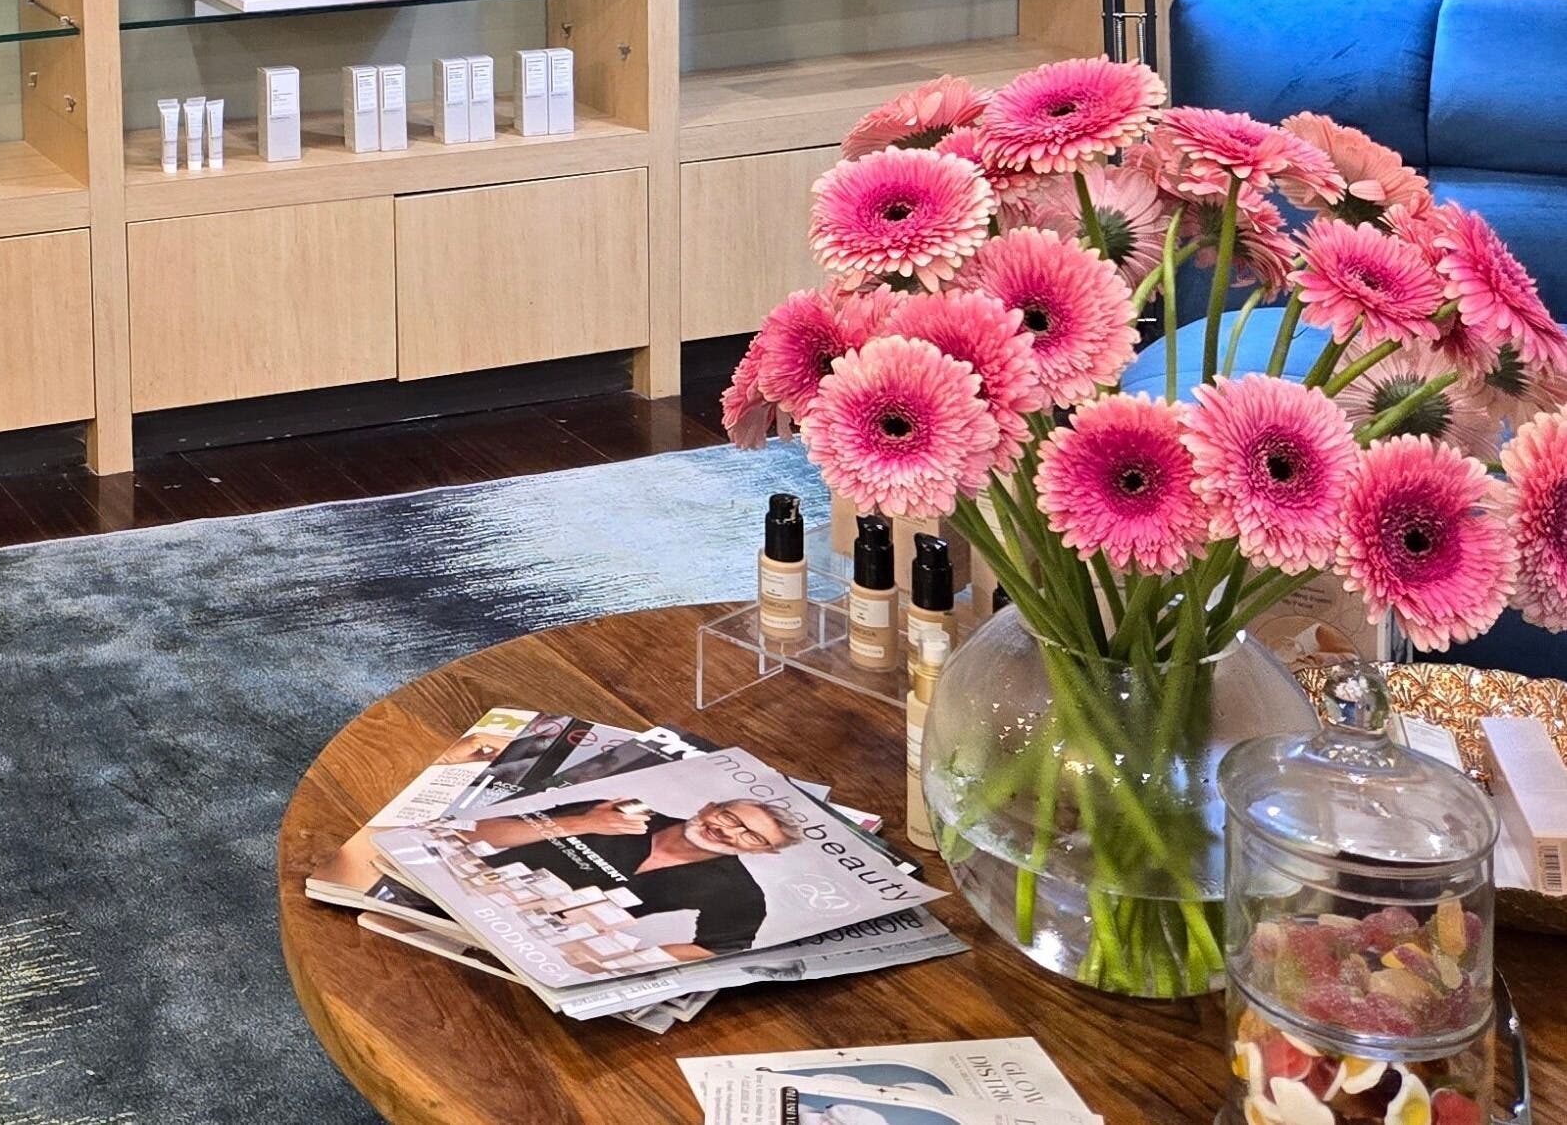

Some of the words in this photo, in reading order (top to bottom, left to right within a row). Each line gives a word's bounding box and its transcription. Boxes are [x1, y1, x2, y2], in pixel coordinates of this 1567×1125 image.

[561, 848, 594, 873] Beauty
[565, 835, 629, 883] MOVEMENT
[474, 907, 570, 982] BIODROGA
[1000, 1061, 1046, 1104] GLOW
